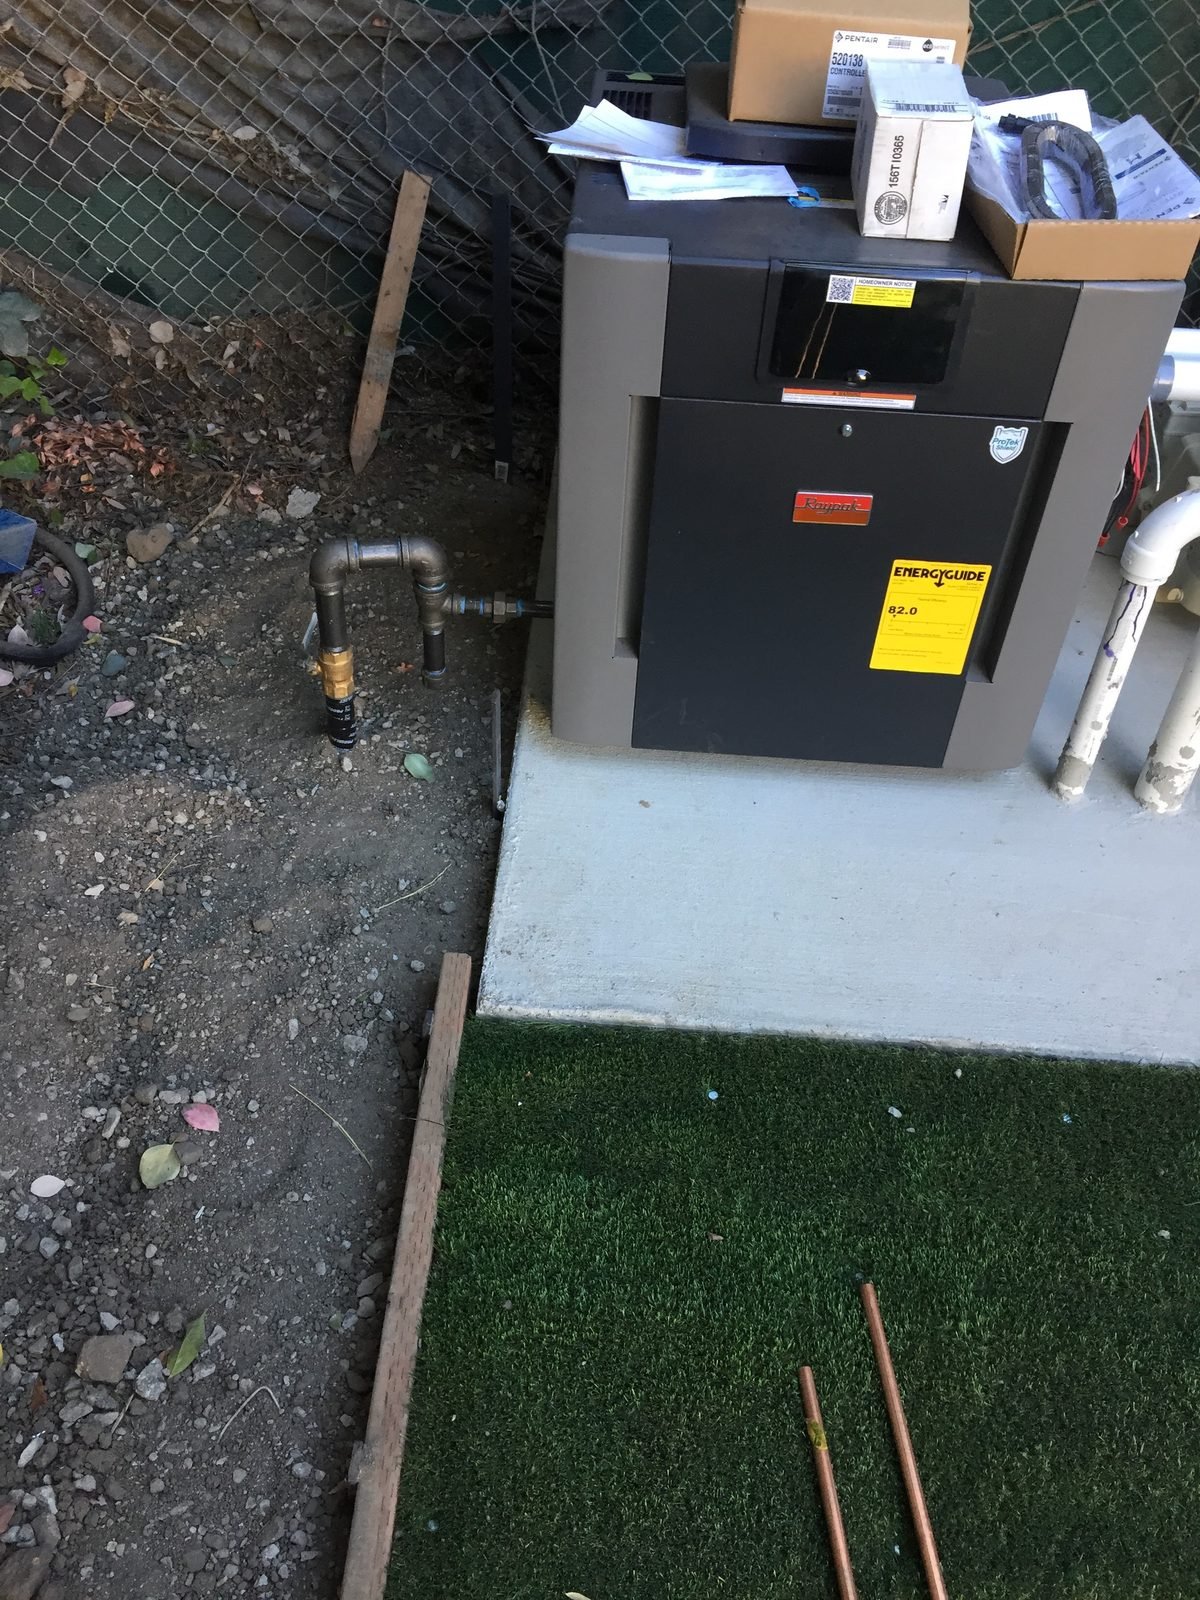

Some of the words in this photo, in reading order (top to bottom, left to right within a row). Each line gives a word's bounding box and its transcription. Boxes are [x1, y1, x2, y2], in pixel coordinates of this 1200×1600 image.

[845, 34, 878, 43] PENTAIR
[832, 52, 863, 67] 520138
[992, 437, 1019, 446] ProTek
[804, 497, 859, 514] Raypak
[893, 566, 986, 584] ENERGYGUIDE
[888, 605, 918, 615] 82.0
